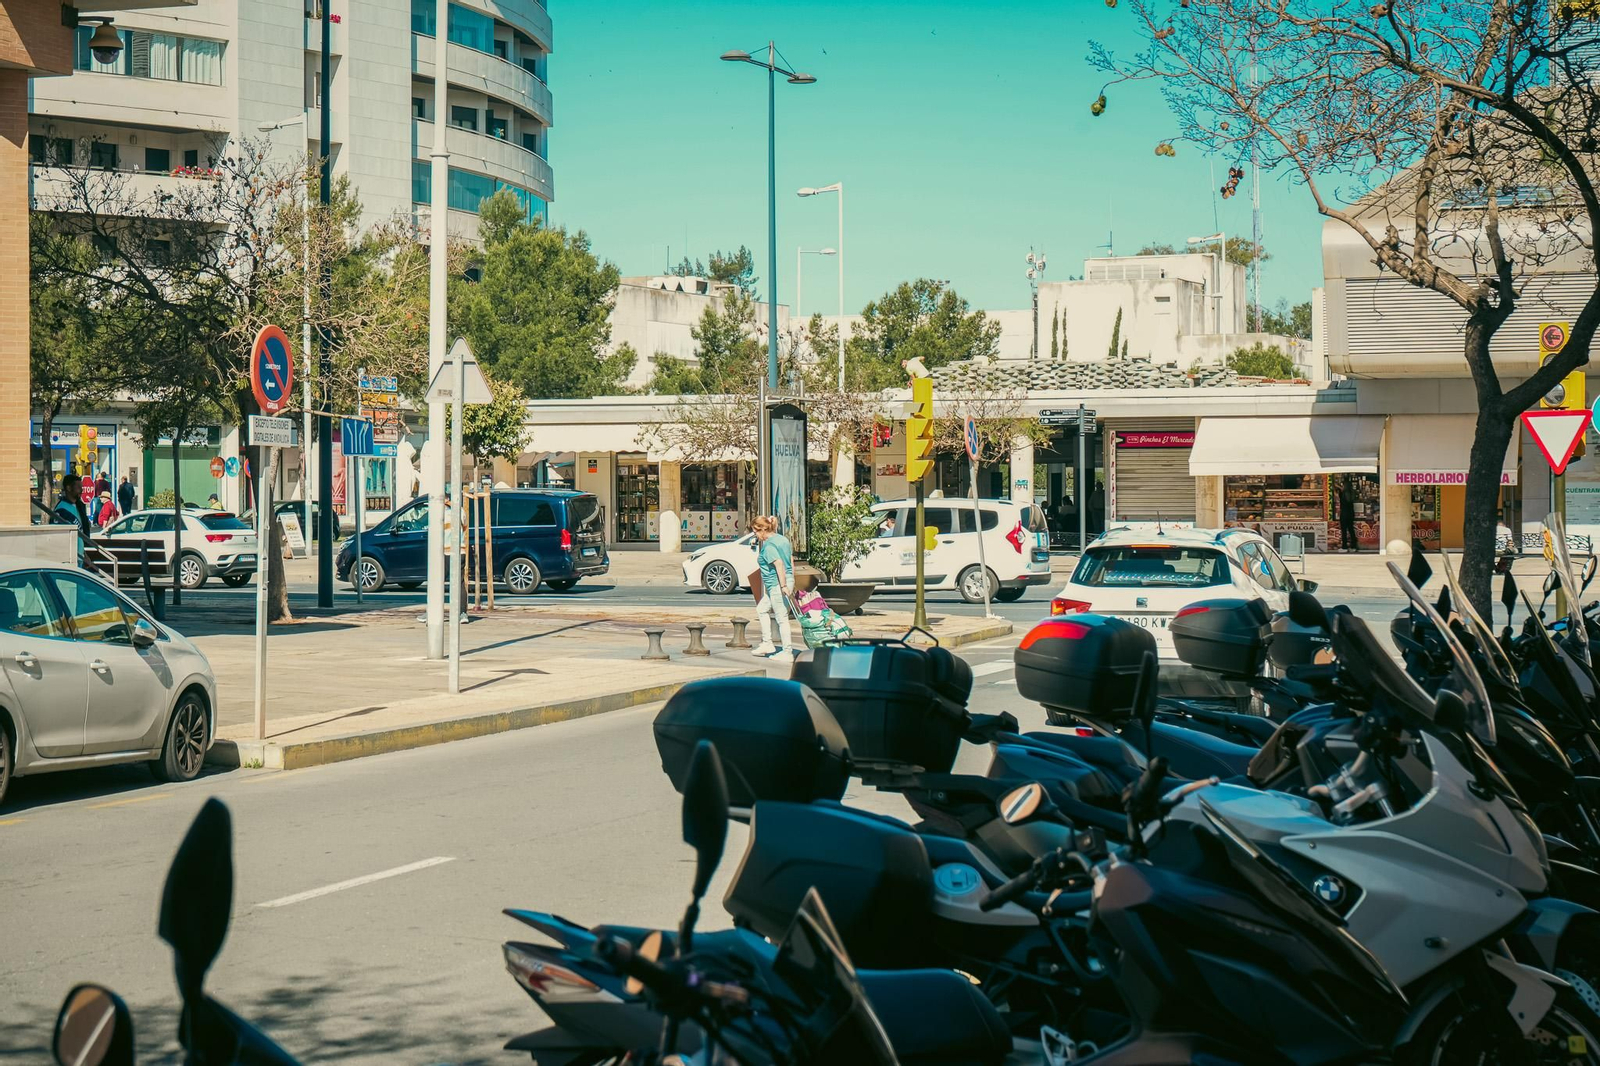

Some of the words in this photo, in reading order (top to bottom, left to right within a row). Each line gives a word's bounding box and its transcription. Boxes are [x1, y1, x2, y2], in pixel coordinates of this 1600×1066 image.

[61, 431, 79, 439] Apues
[774, 444, 800, 457] HUELVA
[1395, 472, 1464, 484] HERBOLARIO
